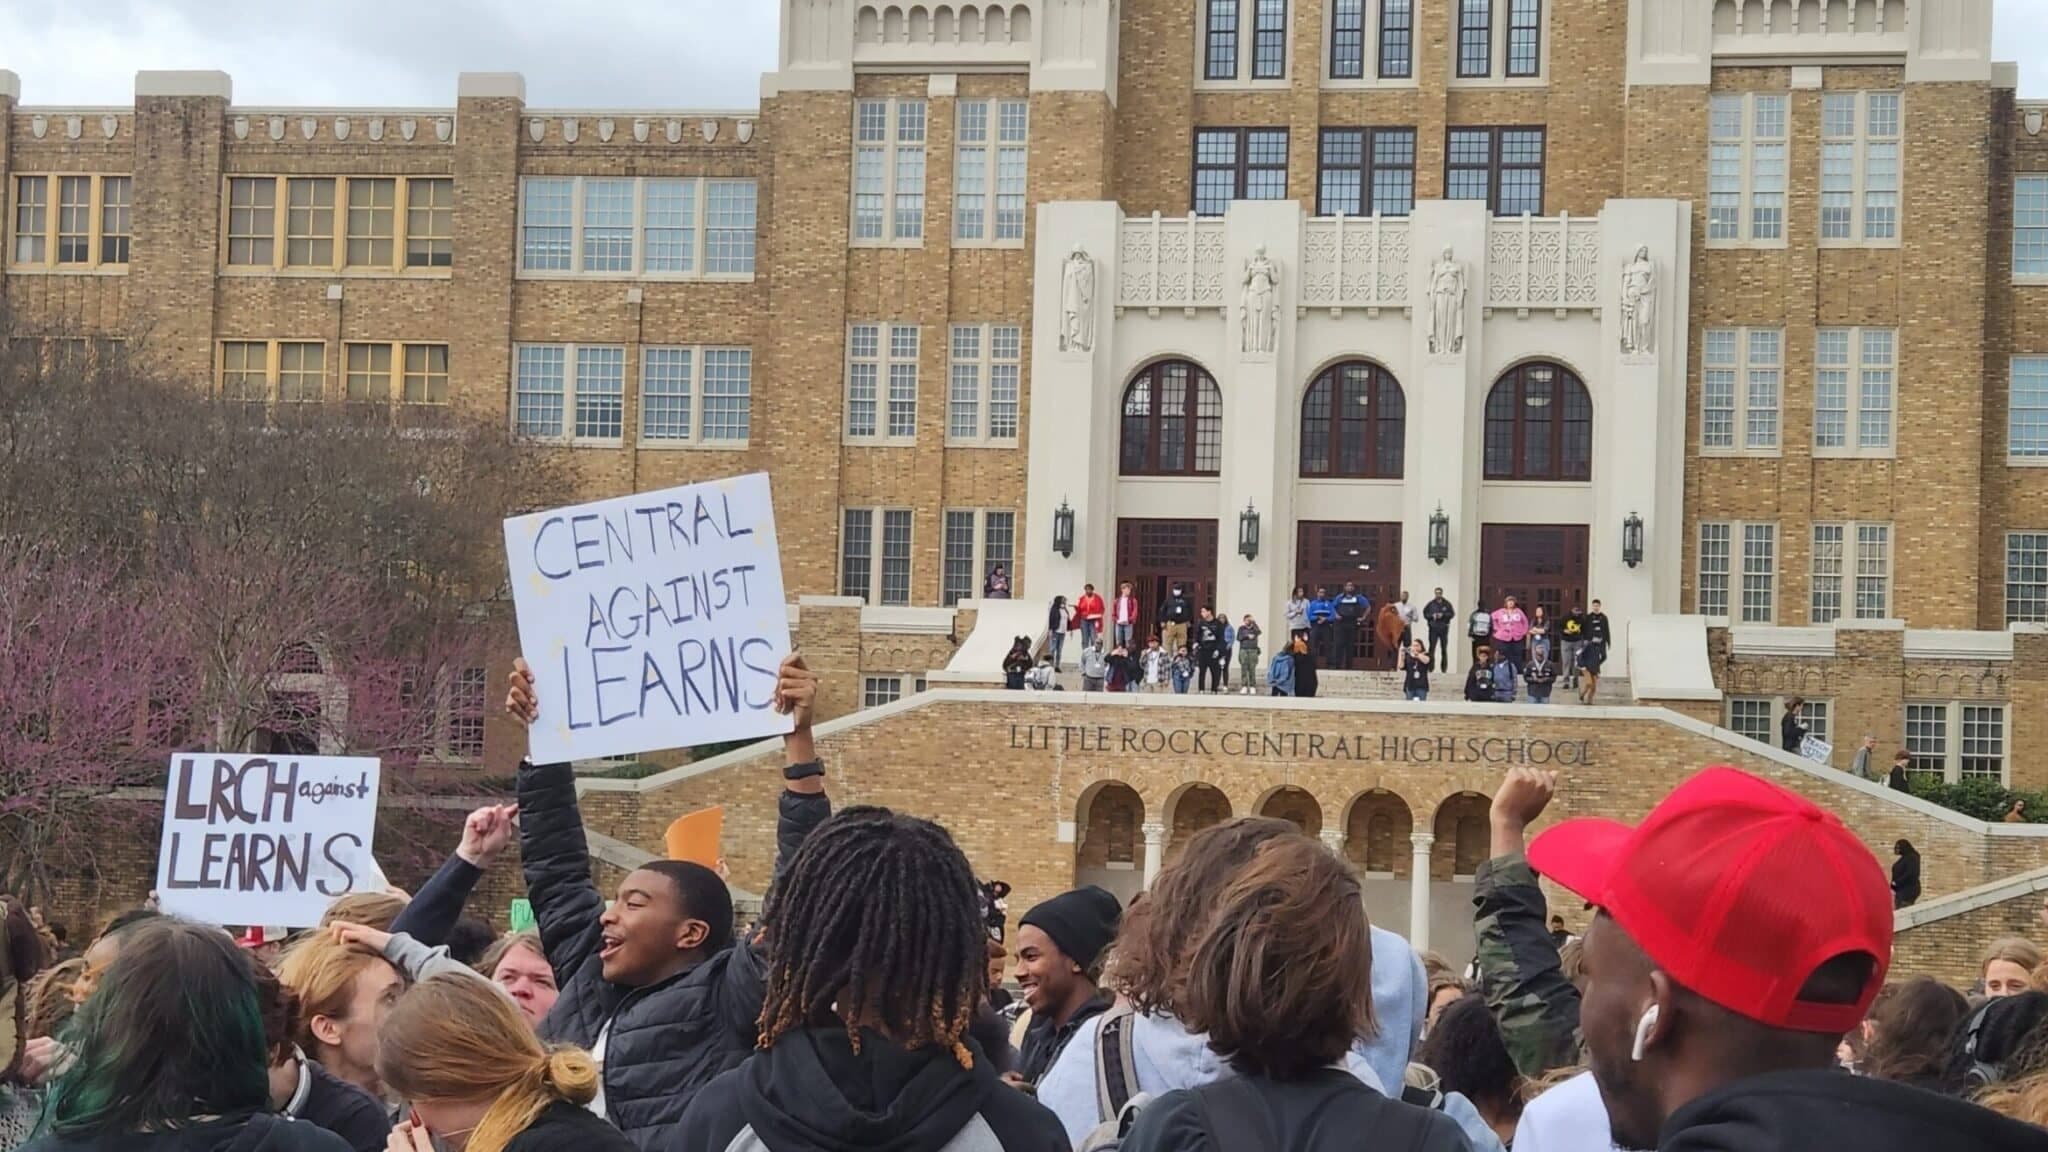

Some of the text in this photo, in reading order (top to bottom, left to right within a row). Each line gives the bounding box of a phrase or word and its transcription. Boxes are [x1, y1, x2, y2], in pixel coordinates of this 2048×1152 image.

[534, 494, 753, 580] CENTRAL
[585, 565, 756, 648] AGAINST
[563, 636, 779, 730] LEARNS
[1009, 724, 1596, 766] LITTLE ROCK CENTRAL HIGH SCHOOL
[174, 758, 370, 825] LRCH against
[167, 832, 362, 897] LEARNS
